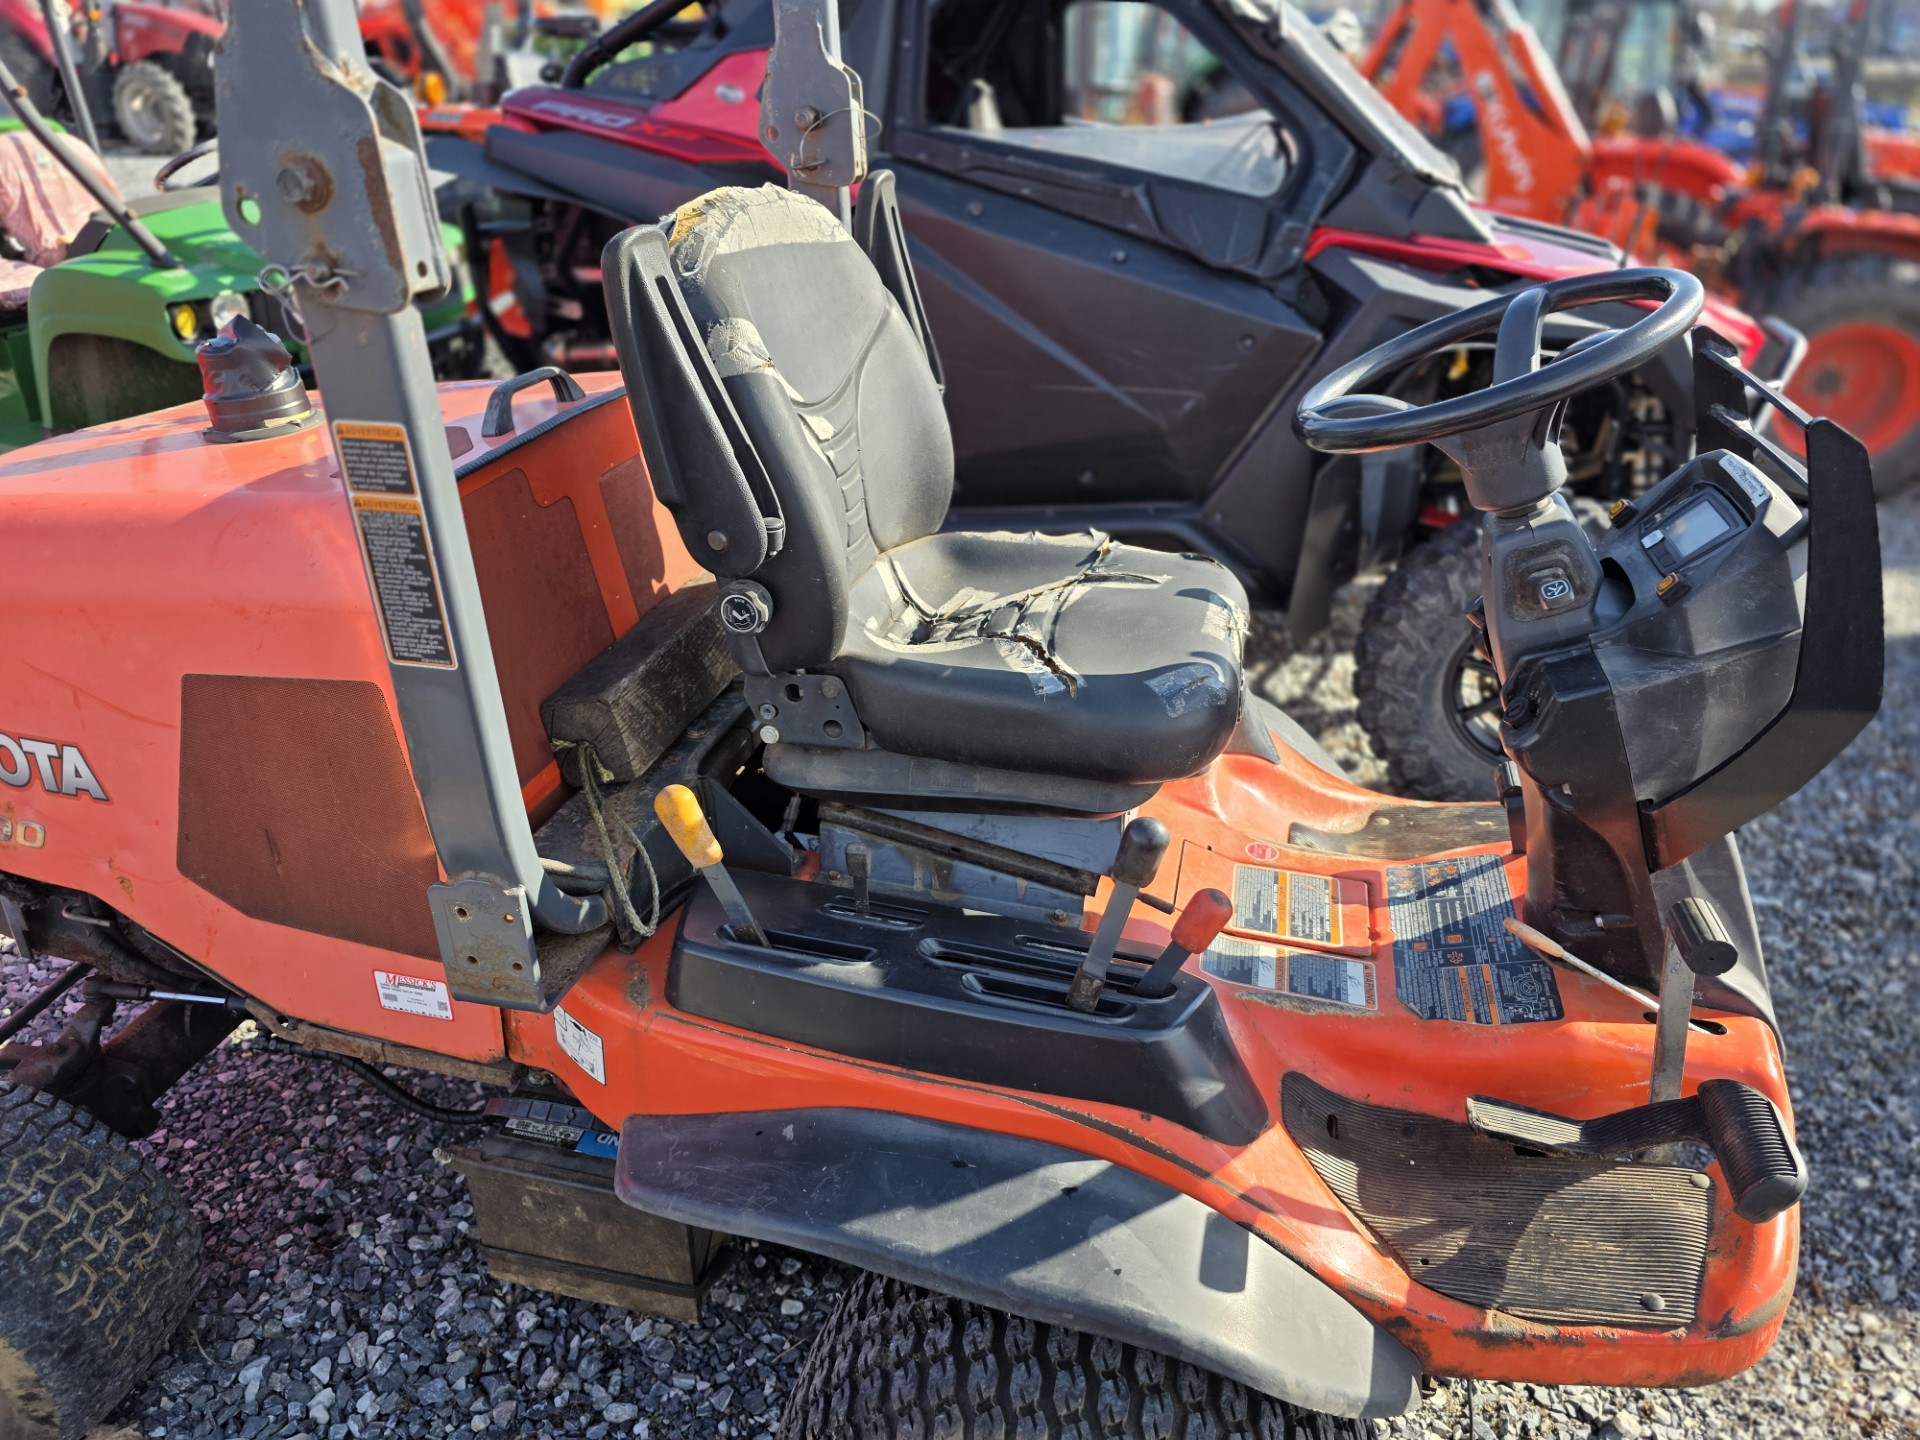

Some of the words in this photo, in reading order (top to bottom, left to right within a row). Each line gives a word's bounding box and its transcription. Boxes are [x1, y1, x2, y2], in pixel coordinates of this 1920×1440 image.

[363, 500, 418, 511] ADVERTENCIA
[385, 973, 437, 988] MESSICK'S
[1276, 956, 1285, 990] ADVERTENCIA
[1365, 973, 1374, 1005] WARNING
[1461, 980, 1471, 1013] ADVERTENCIA
[1486, 984, 1495, 1006] WARNING
